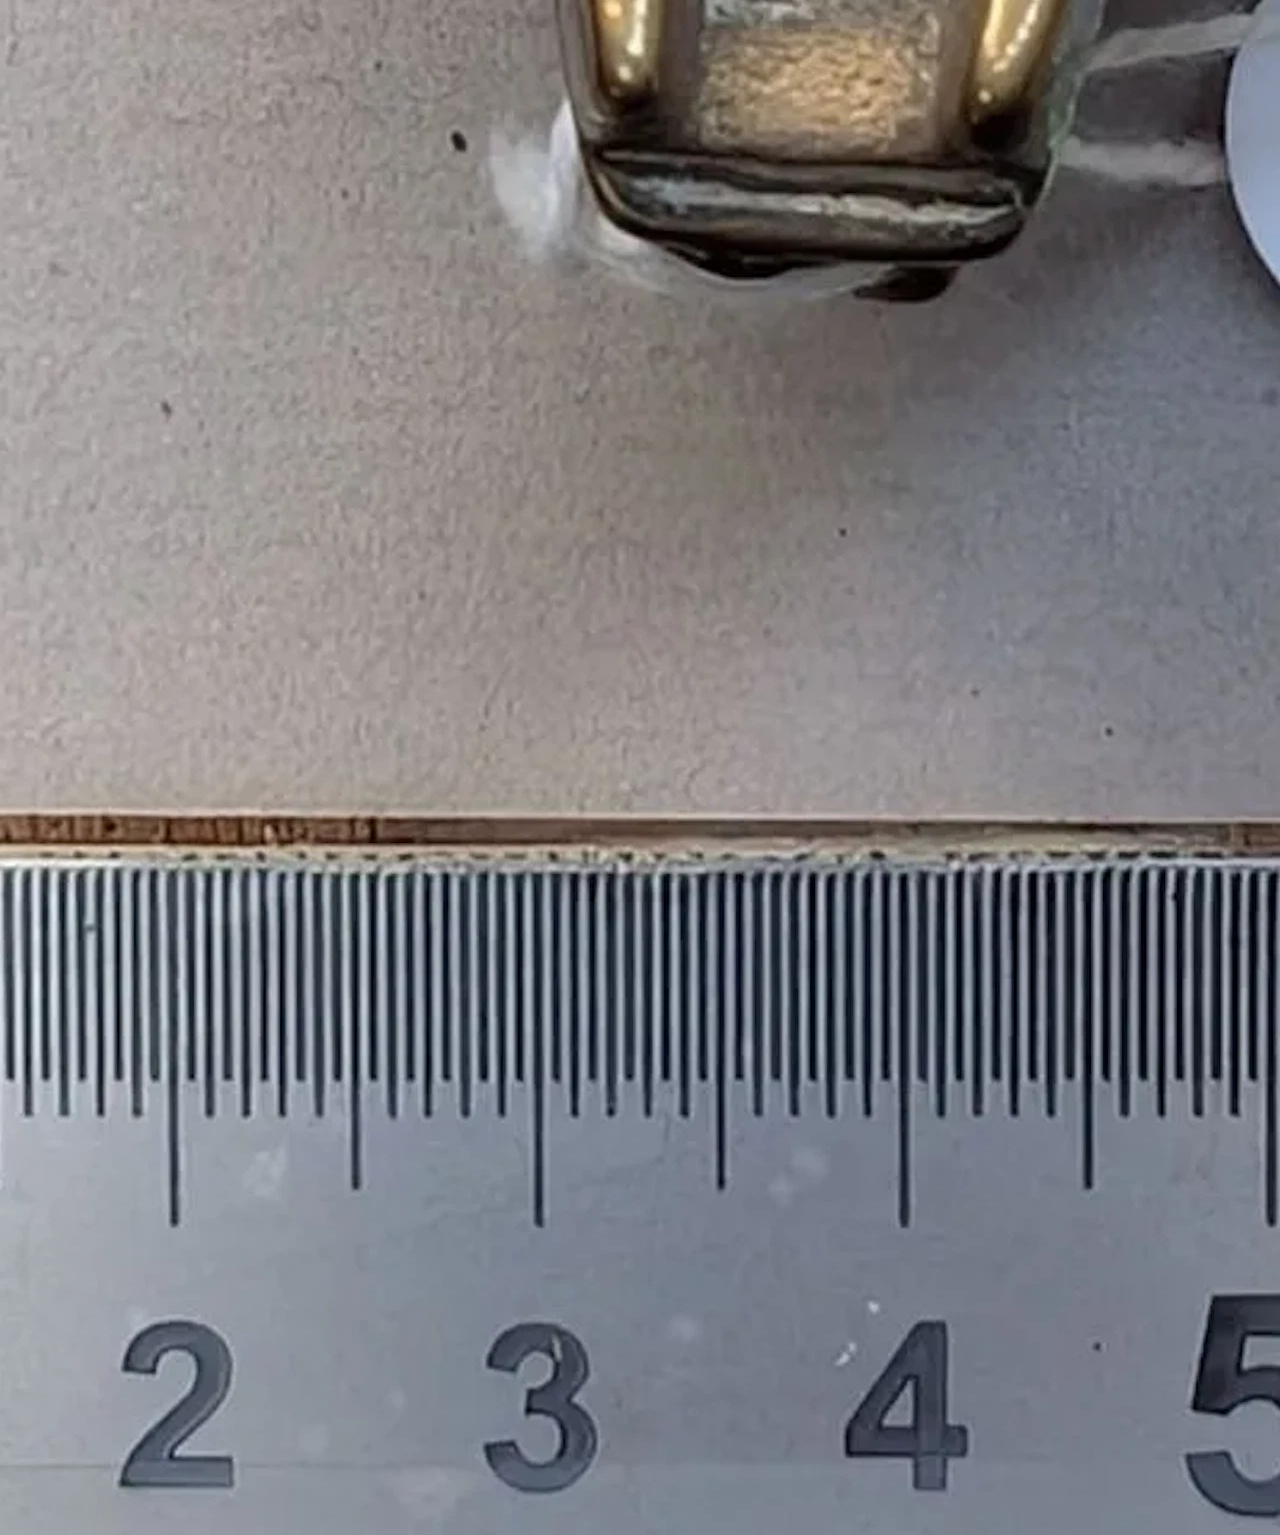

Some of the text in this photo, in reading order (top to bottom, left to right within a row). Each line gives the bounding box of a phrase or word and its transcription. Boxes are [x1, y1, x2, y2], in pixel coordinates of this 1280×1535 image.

[118, 1320, 235, 1489] 2
[483, 1322, 599, 1493] 3
[844, 1320, 970, 1492] 4
